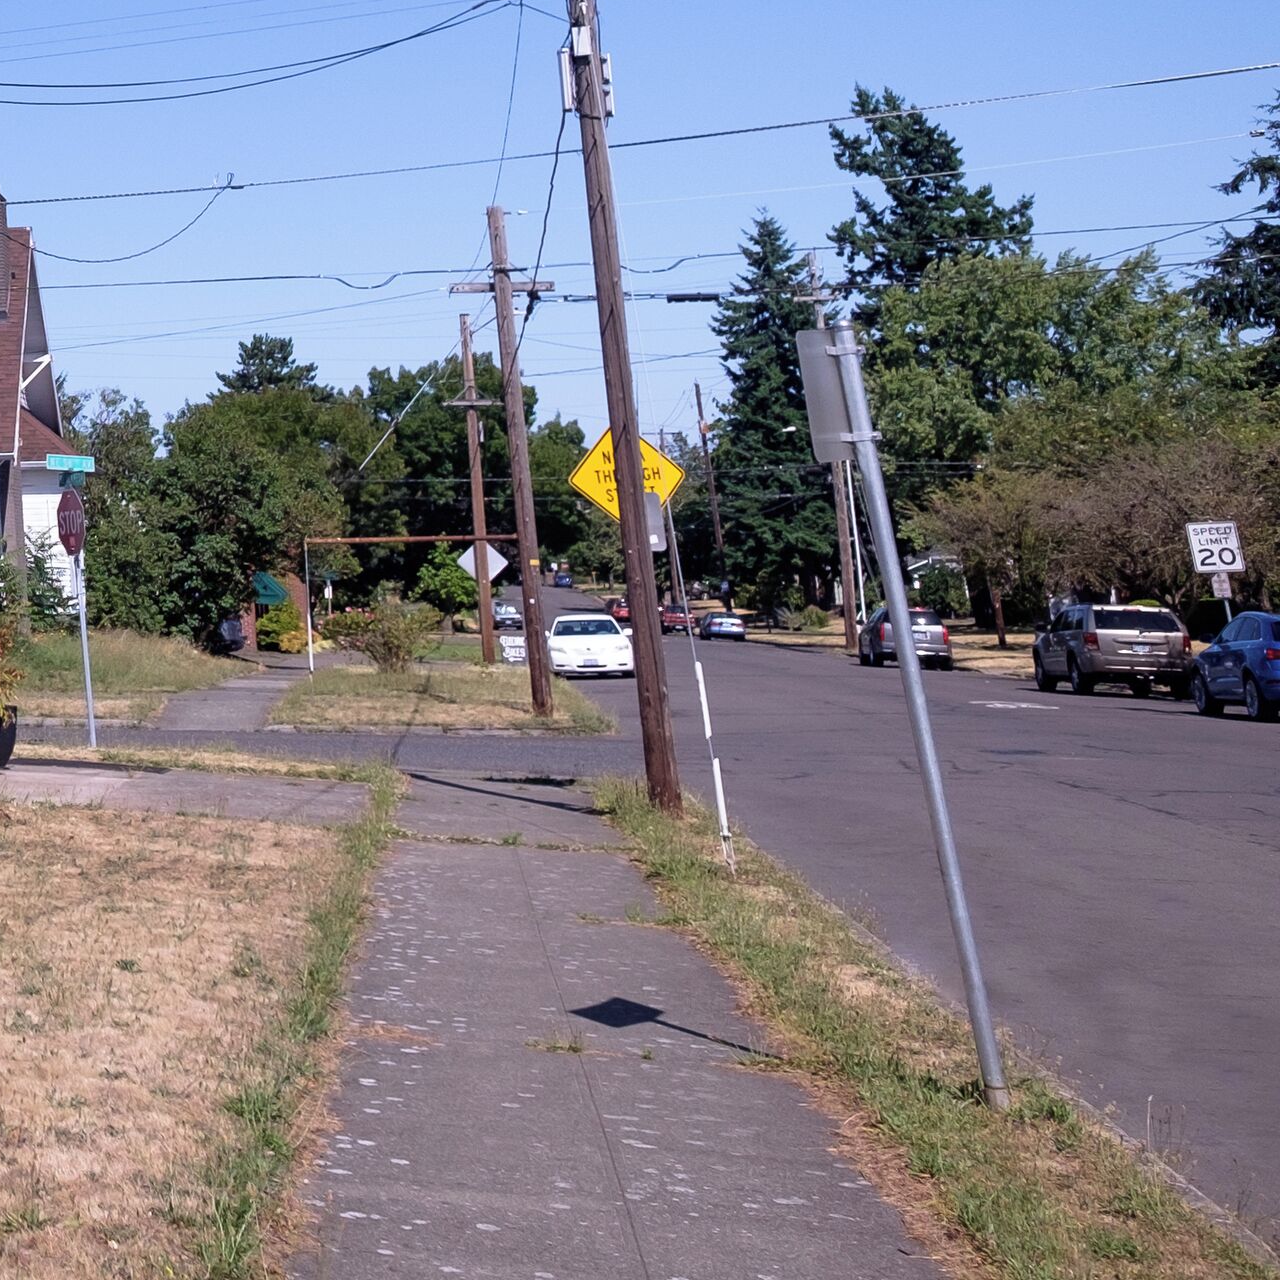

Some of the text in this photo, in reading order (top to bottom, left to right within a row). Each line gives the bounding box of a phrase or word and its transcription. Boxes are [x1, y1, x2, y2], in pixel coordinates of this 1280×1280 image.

[594, 467, 661, 484] THGH
[59, 510, 82, 535] STOP
[1192, 526, 1232, 536] SPEED
[1198, 537, 1229, 546] LIMIT
[1198, 547, 1237, 567] 20
